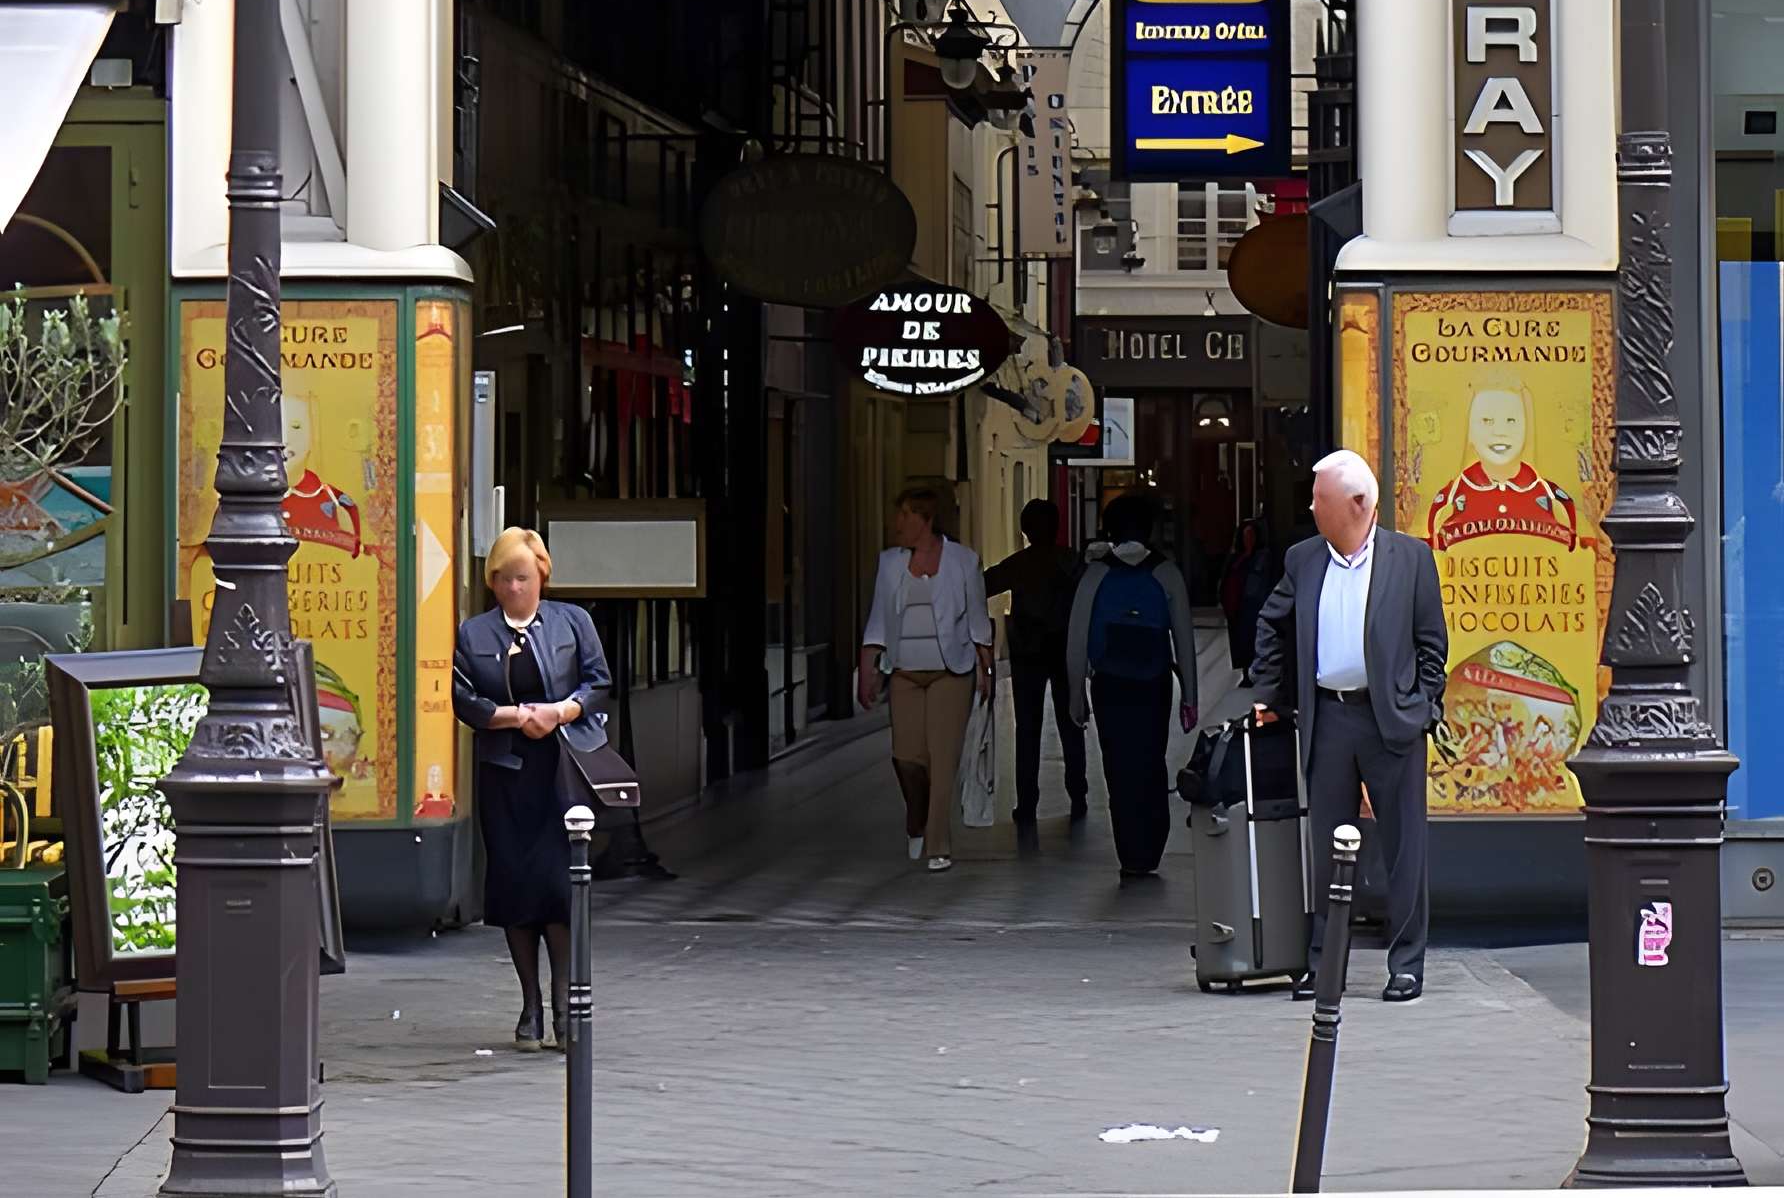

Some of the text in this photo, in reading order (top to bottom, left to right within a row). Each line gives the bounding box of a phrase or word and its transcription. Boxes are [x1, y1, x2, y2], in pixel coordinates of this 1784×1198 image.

[869, 292, 972, 314] AMOUR
[281, 325, 348, 344] URE
[902, 320, 941, 340] DE
